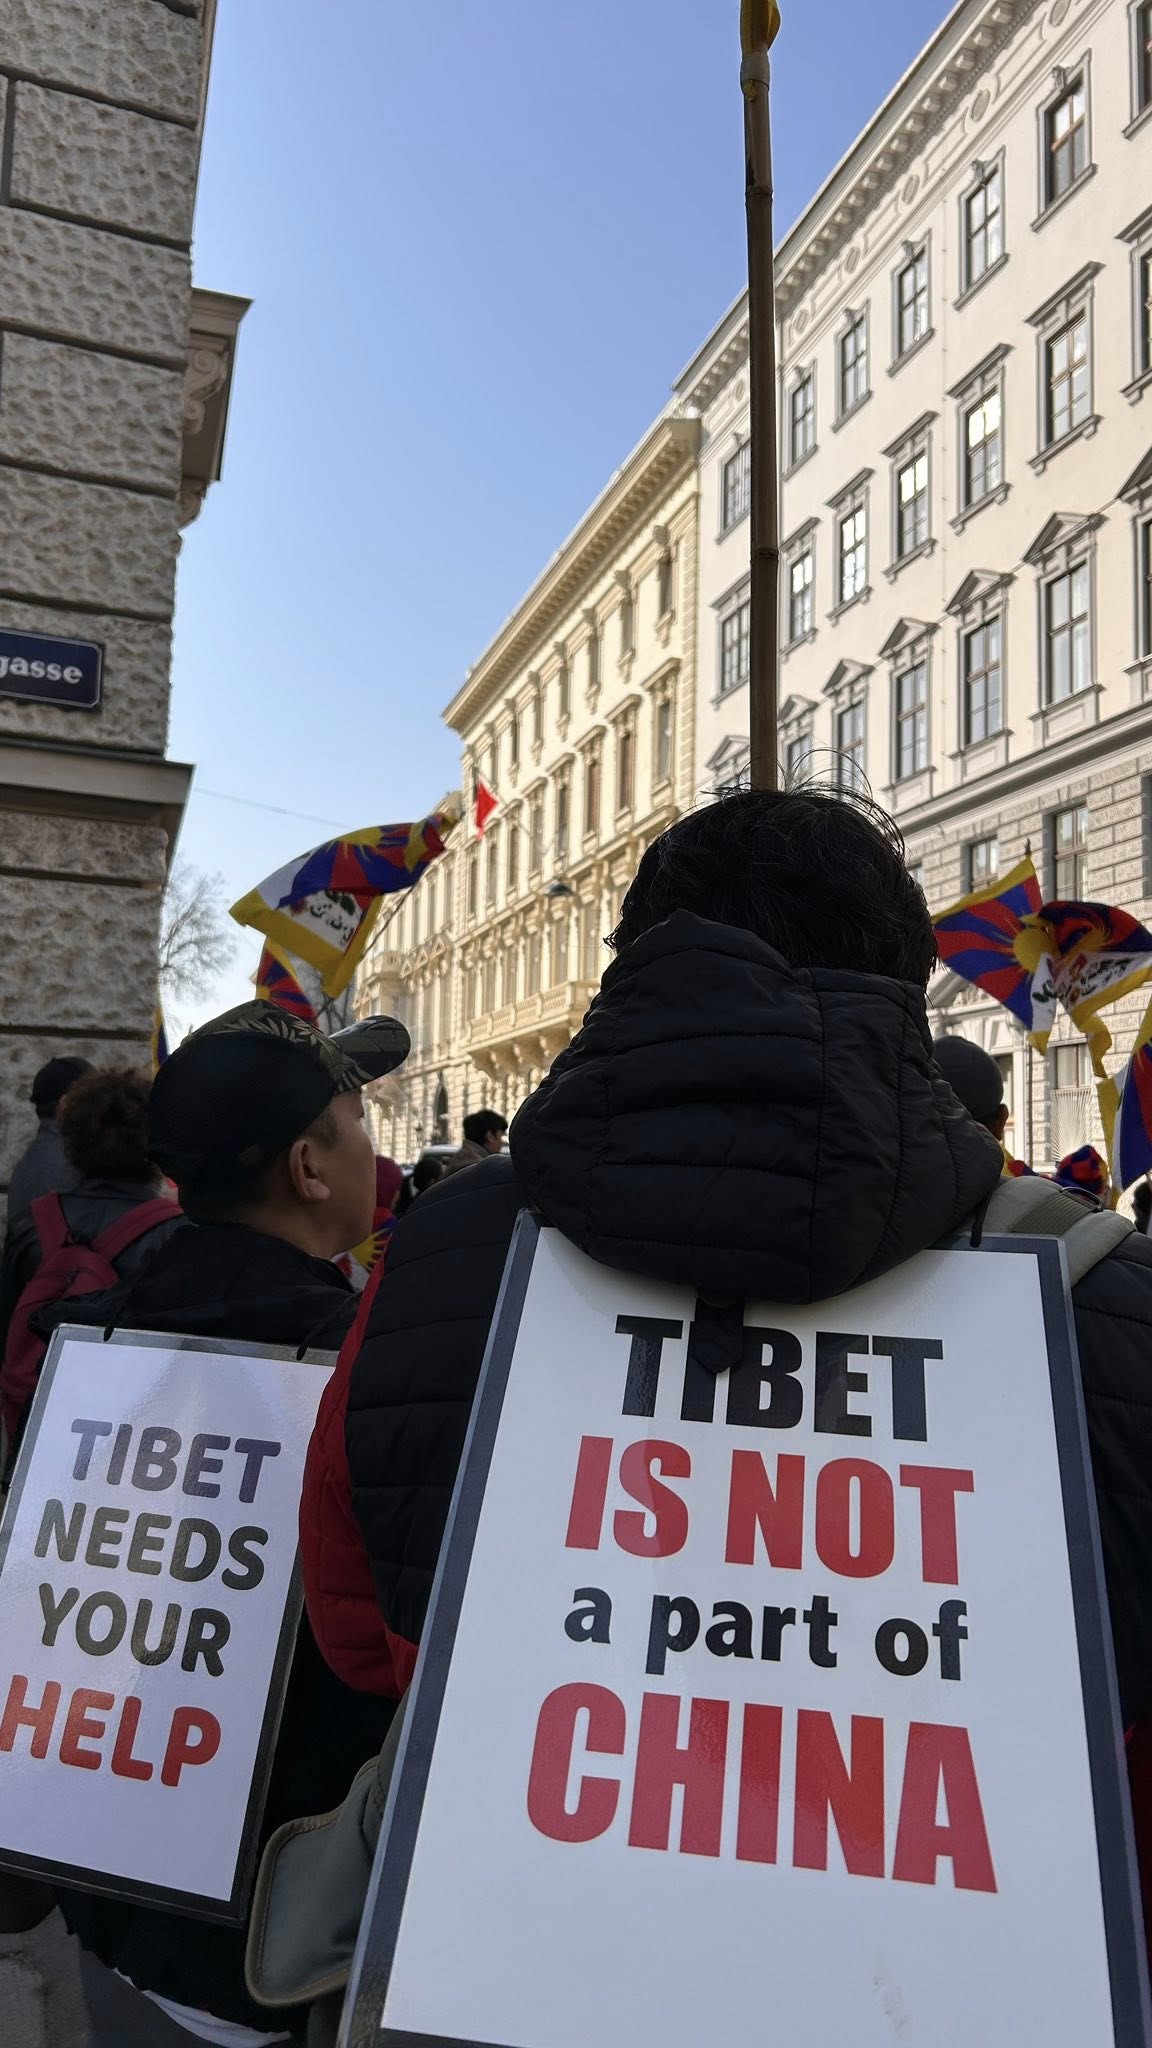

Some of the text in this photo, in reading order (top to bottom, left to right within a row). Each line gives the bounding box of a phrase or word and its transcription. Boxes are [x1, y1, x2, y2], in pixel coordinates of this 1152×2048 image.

[615, 1314, 943, 1442] TIBET
[71, 1418, 281, 1503] TIBET
[565, 1435, 974, 1585] IS NOT
[34, 1499, 269, 1590] NEEDS
[38, 1583, 231, 1677] YOUR
[564, 1587, 969, 1681] a part of
[0, 1674, 221, 1787] HELP
[526, 1682, 998, 1893] CHINA
